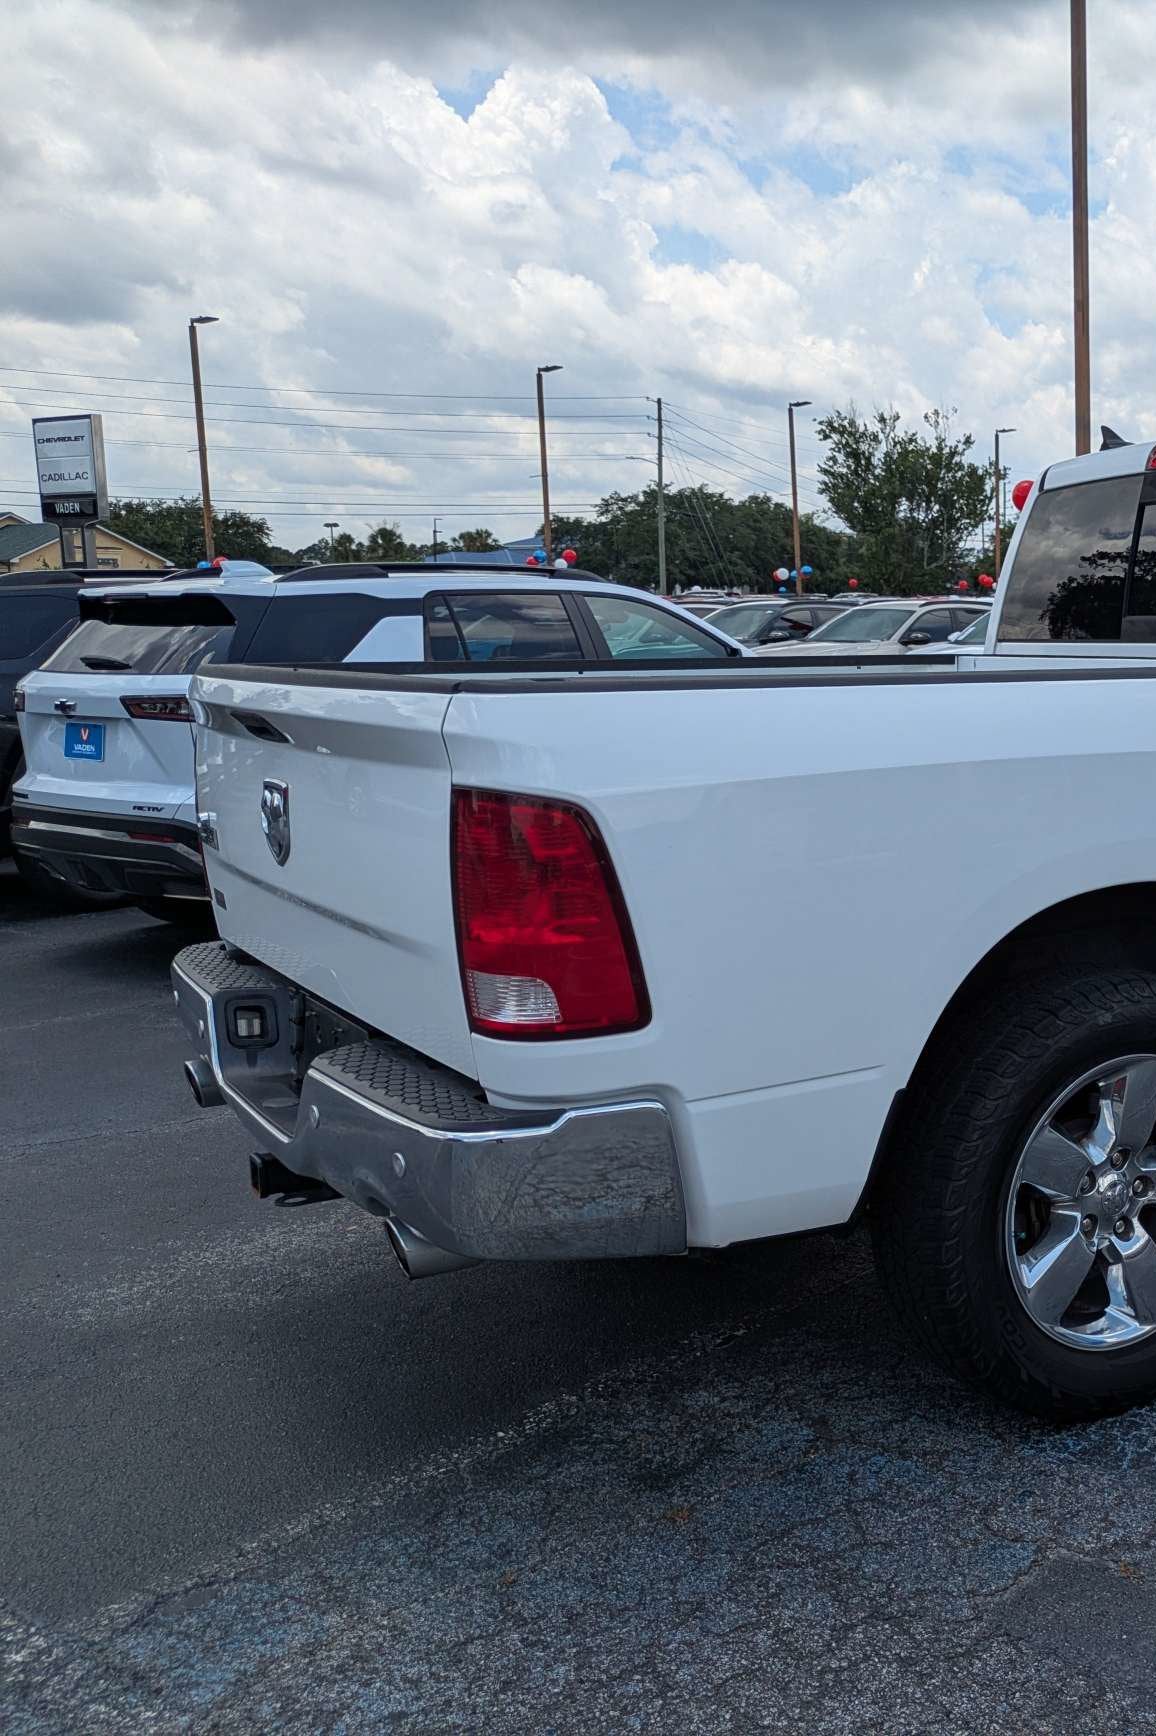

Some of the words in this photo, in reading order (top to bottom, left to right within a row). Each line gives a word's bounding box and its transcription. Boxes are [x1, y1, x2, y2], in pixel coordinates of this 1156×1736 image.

[37, 435, 86, 444] CHEVROLET
[41, 472, 89, 482] CADILLAC
[55, 502, 80, 514] VADEN
[73, 743, 96, 752] VADEN
